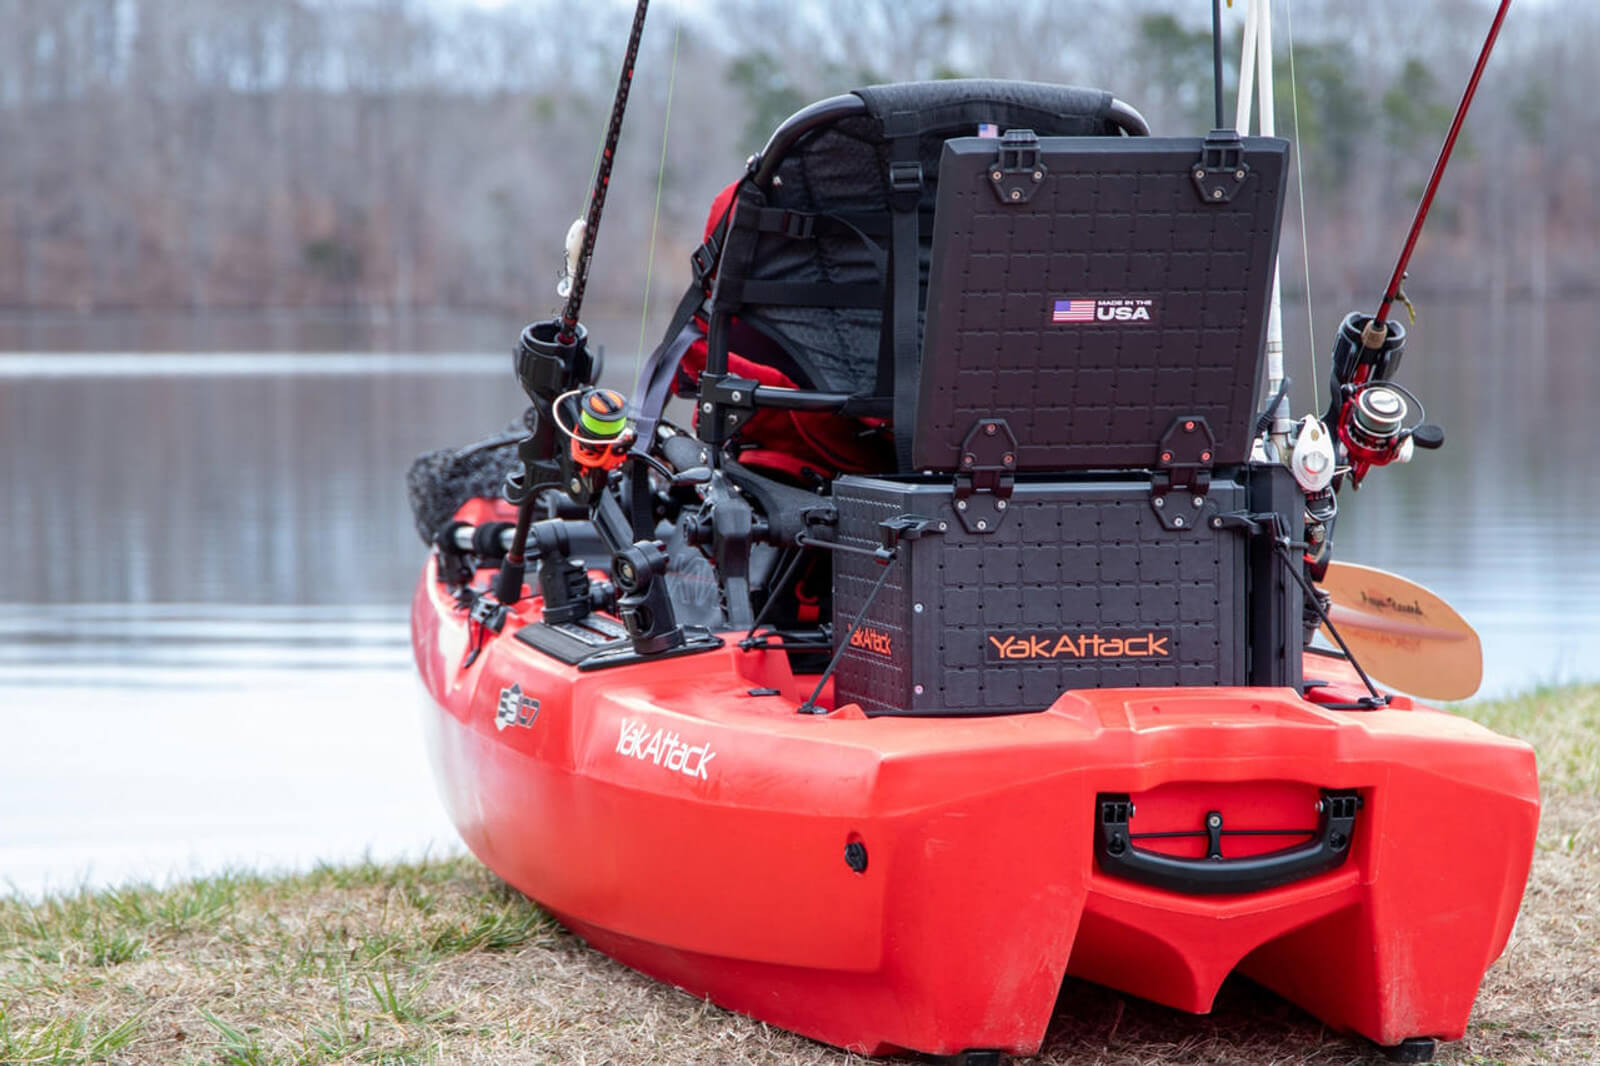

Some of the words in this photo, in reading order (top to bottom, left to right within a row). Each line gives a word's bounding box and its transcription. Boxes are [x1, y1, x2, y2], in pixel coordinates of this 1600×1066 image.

[1096, 306, 1150, 321] USA
[988, 632, 1169, 659] YakAttack
[615, 717, 716, 780] YakAttack
